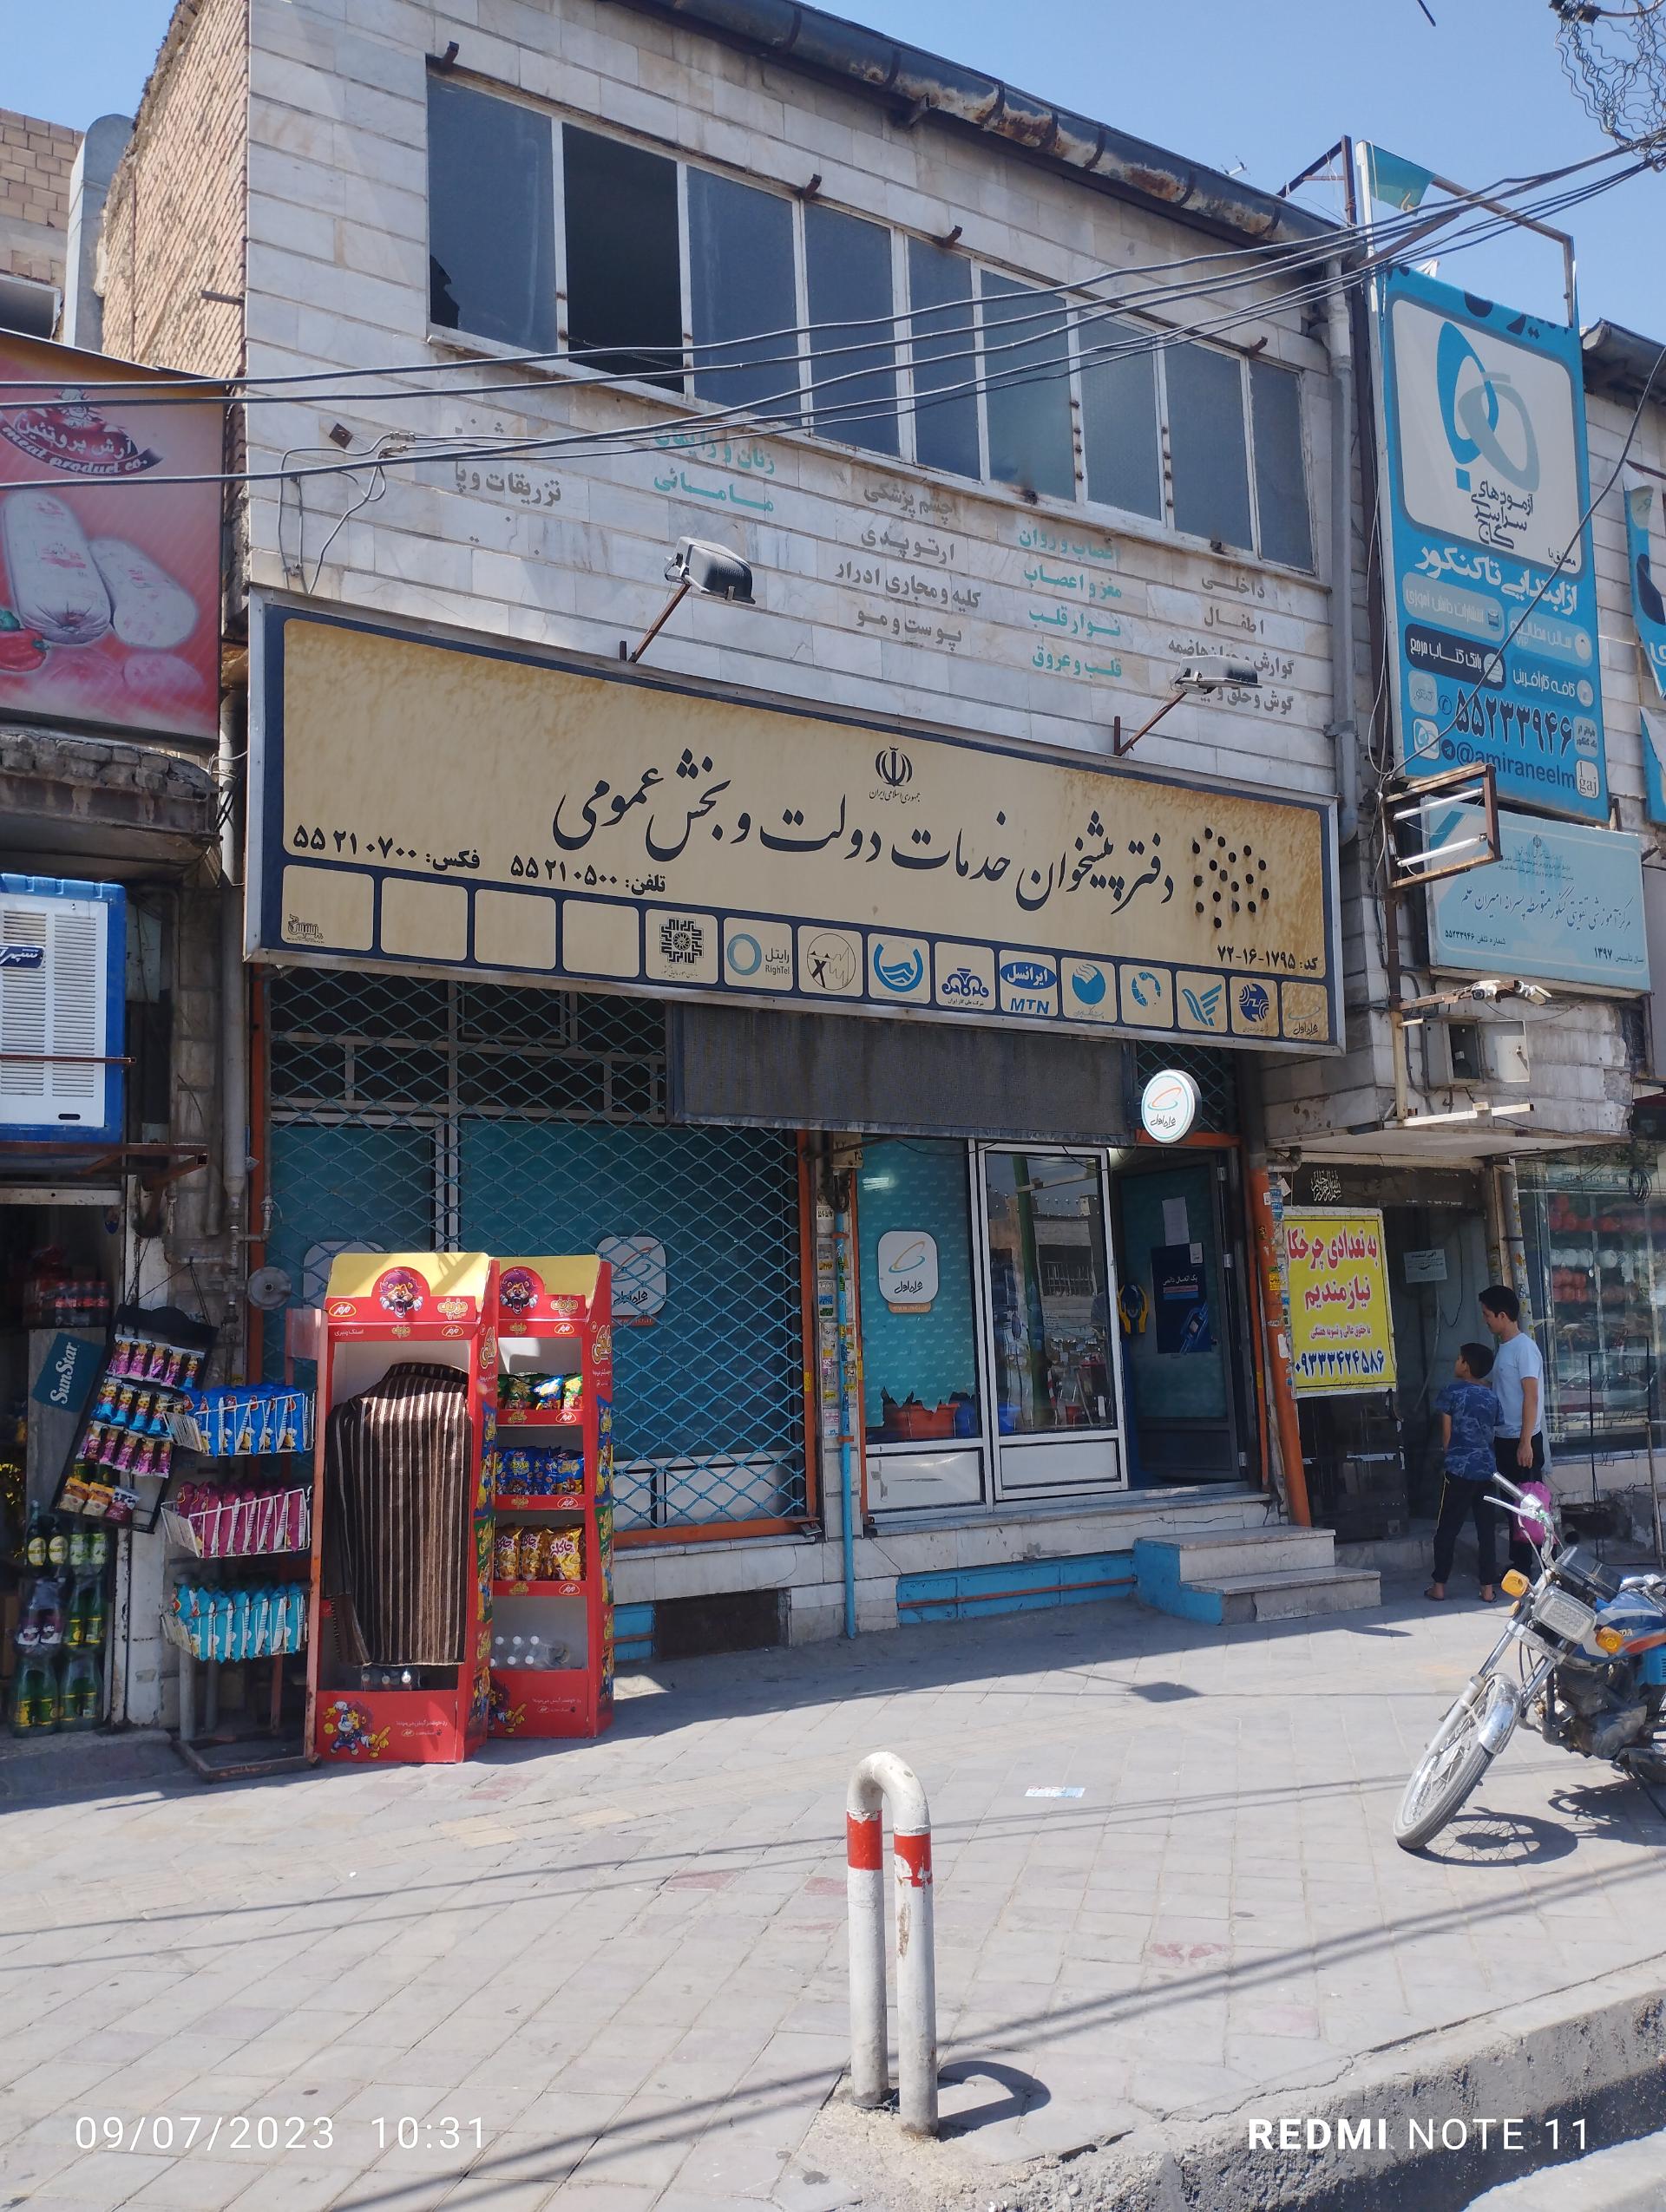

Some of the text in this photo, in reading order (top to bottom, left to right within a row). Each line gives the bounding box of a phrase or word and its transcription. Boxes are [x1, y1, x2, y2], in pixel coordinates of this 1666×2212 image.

[723, 442, 732, 464] و
[738, 443, 775, 475] زنان
[49, 456, 121, 474] product
[469, 471, 481, 491] و
[485, 473, 562, 507] تزریقات
[863, 482, 915, 519] پزشکی
[1414, 546, 1486, 580] کنکور
[835, 561, 981, 612] کلیه و مجاری ادرار
[1024, 564, 1084, 592] اعصاب
[1201, 576, 1265, 599] داخلی
[1089, 582, 1096, 599] و
[856, 610, 888, 627] مو
[891, 618, 901, 635] و
[1028, 605, 1121, 638] نوار قلب
[1204, 605, 1264, 636] اطفال
[1410, 638, 1428, 657] مرجع
[1428, 643, 1465, 664] کتاب
[1032, 645, 1122, 679] قلب و عروق
[1253, 652, 1295, 679] گوارش
[1253, 691, 1261, 709] و
[1263, 690, 1295, 715] گوش
[1579, 776, 1597, 797] gaj
[552, 748, 1174, 915] دفتر پیشخوان خدمات دولت و بخش عمومی
[764, 948, 790, 964] رایتل
[764, 965, 790, 976] RighTel
[1007, 964, 1049, 986] ایرانسل
[1009, 998, 1050, 1015] MTN
[1150, 1114, 1164, 1126] اول
[1327, 1227, 1366, 1269] تعدادی
[1368, 1234, 1378, 1266] به
[894, 1279, 924, 1294] همراه اول
[1304, 1275, 1372, 1311] نیازمندیم
[49, 1341, 78, 1404] SunStar
